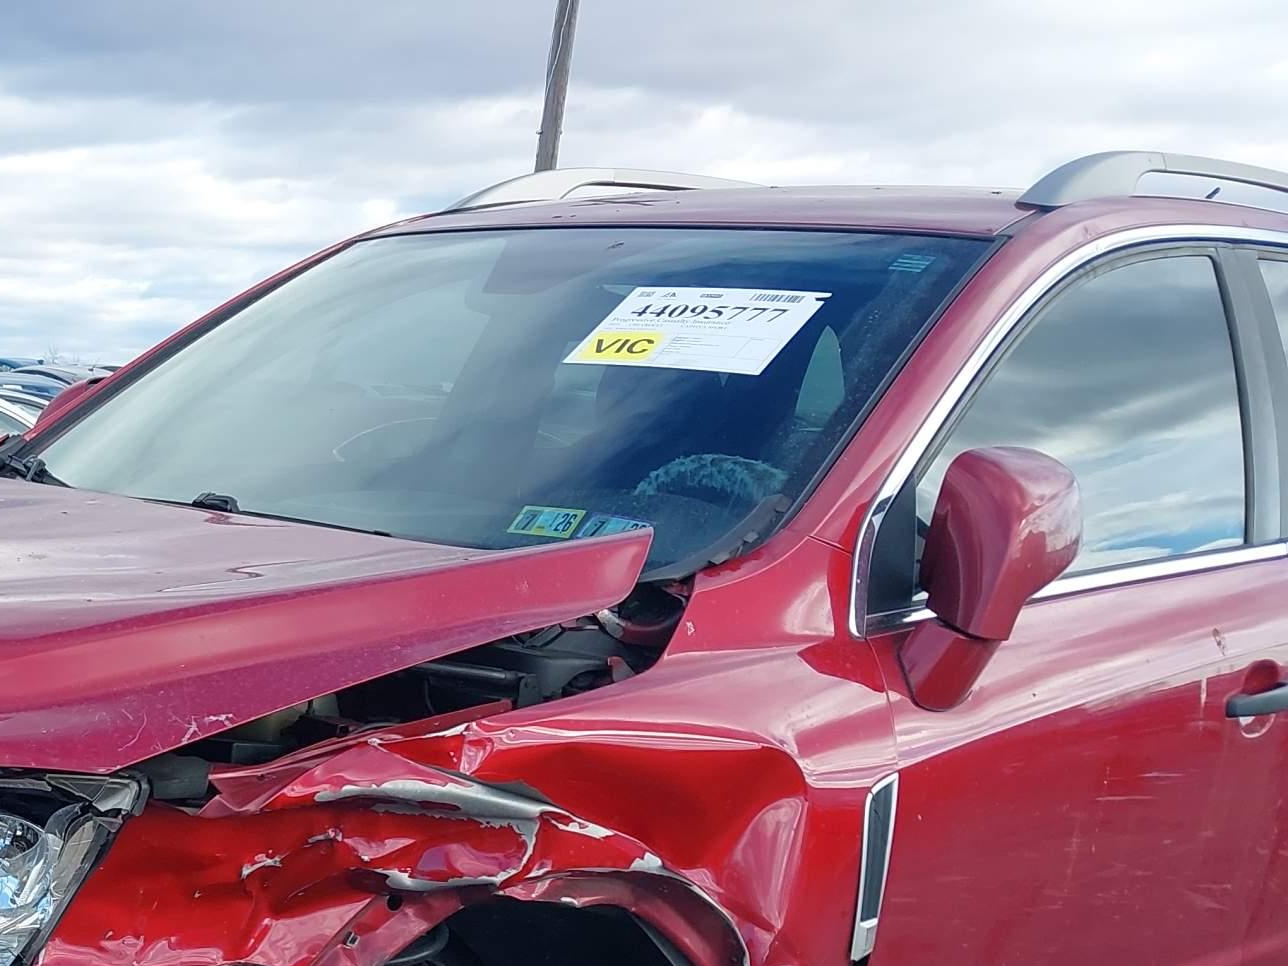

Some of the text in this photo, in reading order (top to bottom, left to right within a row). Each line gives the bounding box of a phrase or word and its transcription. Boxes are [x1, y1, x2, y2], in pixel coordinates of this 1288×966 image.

[630, 303, 790, 322] 44095777
[594, 338, 655, 354] VIC
[520, 512, 578, 533] 7 26
